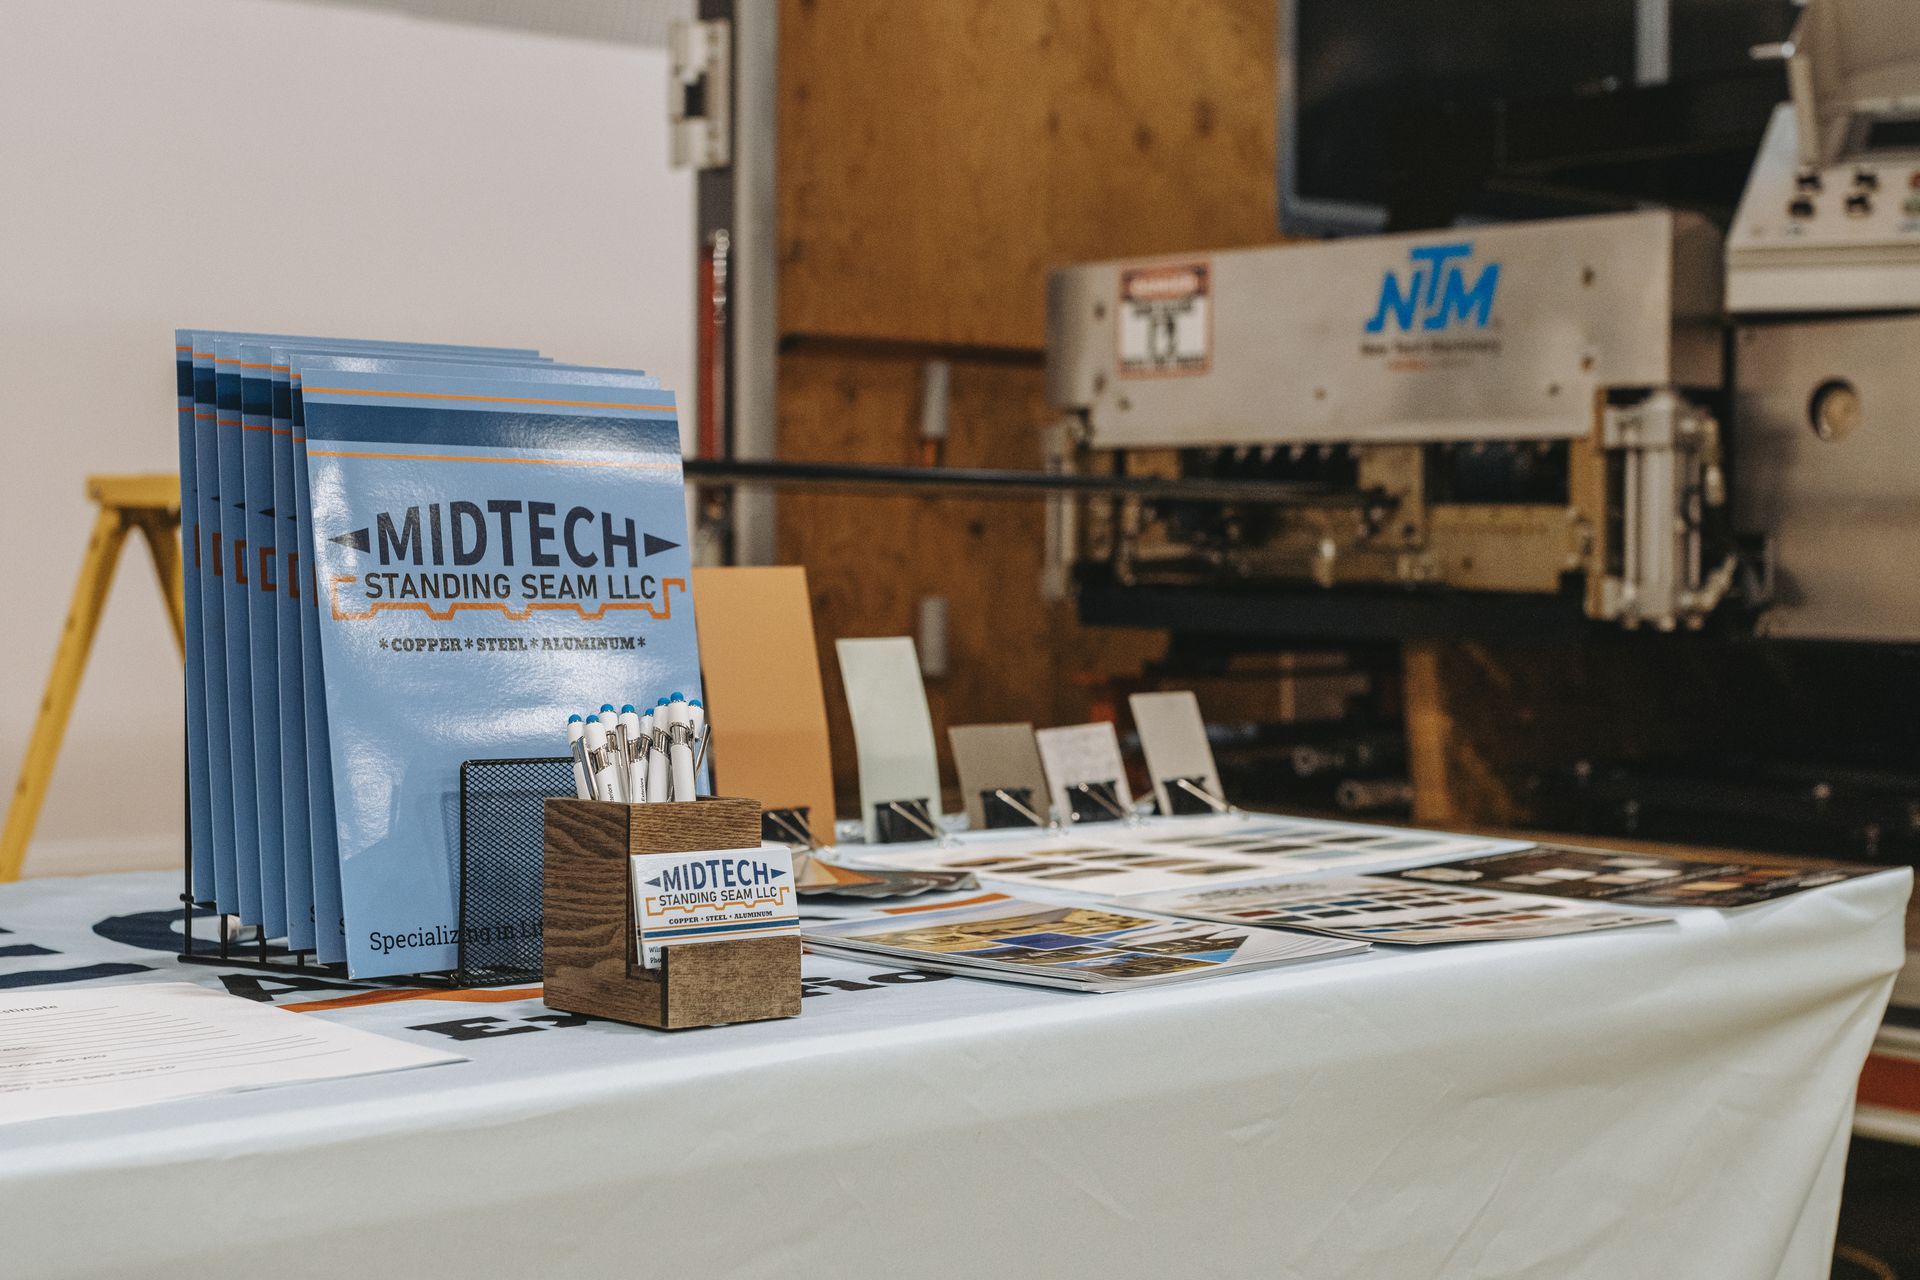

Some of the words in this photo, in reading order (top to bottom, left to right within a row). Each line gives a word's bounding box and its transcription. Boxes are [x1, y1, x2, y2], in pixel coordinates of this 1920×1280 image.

[1364, 243, 1501, 333] NTM
[376, 500, 639, 568] MIDTECH
[364, 572, 512, 600] STANDING
[521, 574, 599, 600] SEAM
[607, 574, 657, 600] LLC
[662, 859, 769, 892] MIDTECH
[659, 891, 717, 907] STANDING
[720, 888, 753, 902] SEAM
[756, 886, 778, 899] LLC
[669, 916, 699, 925] COPPER
[705, 914, 728, 922] STEEL
[734, 910, 773, 920] ALUMINUM
[369, 924, 492, 955] Specializng
